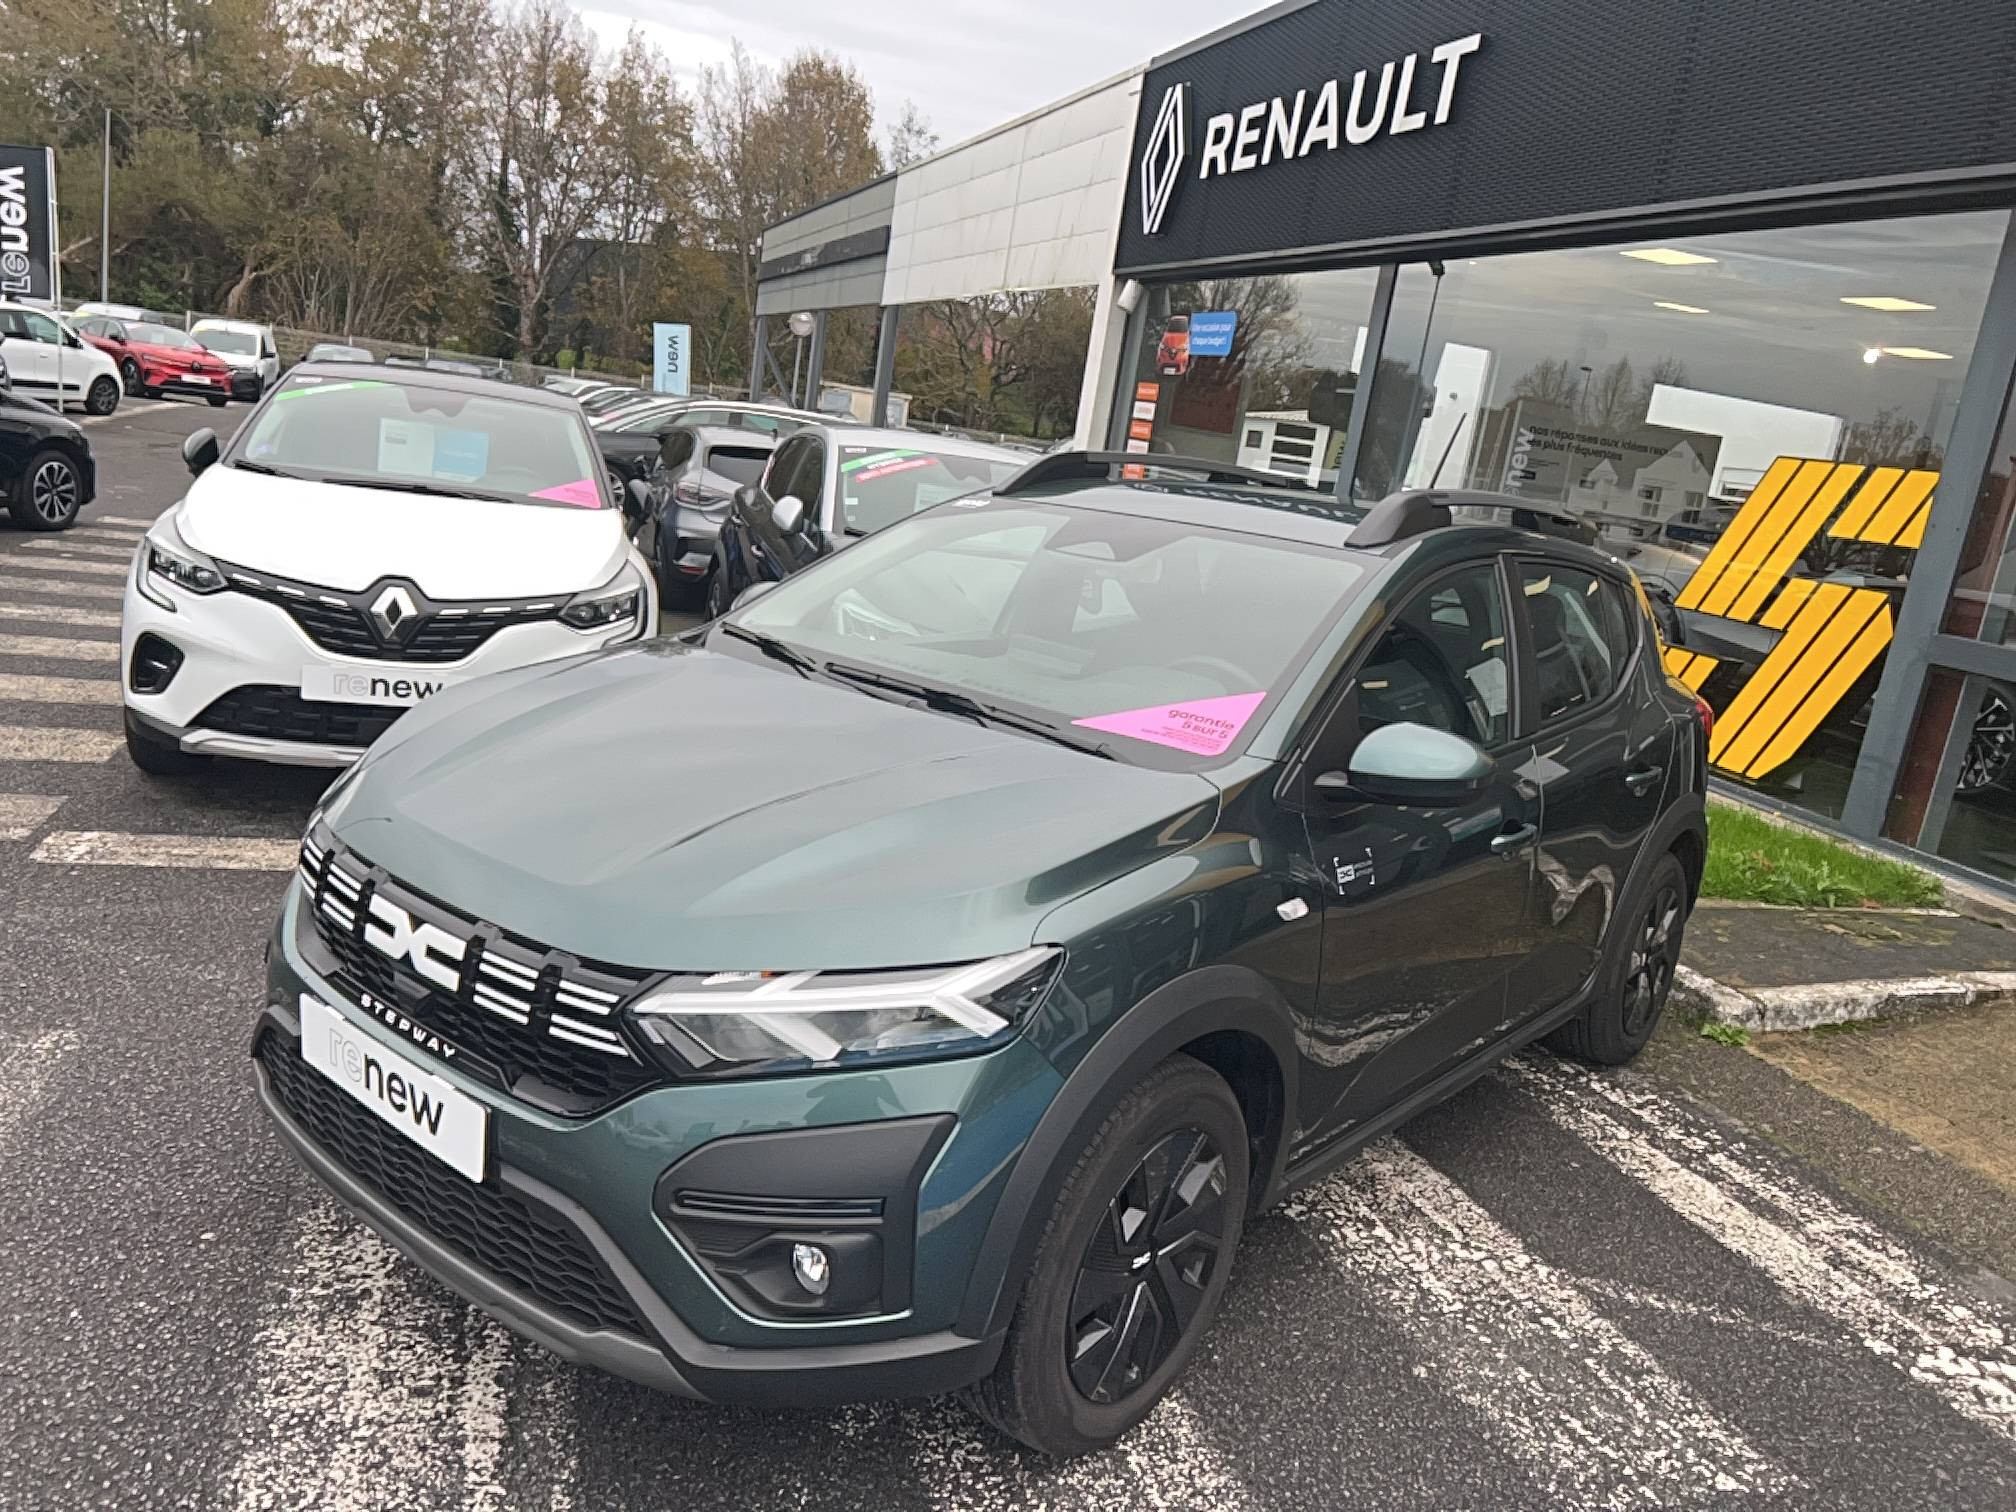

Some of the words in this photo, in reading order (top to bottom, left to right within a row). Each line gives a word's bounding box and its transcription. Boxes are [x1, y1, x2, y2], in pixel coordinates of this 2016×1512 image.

[1199, 33, 1482, 180] RENAULT
[1168, 709, 1234, 729] garantie
[360, 992, 456, 1058] STEPWAY
[329, 1027, 444, 1136] renew
